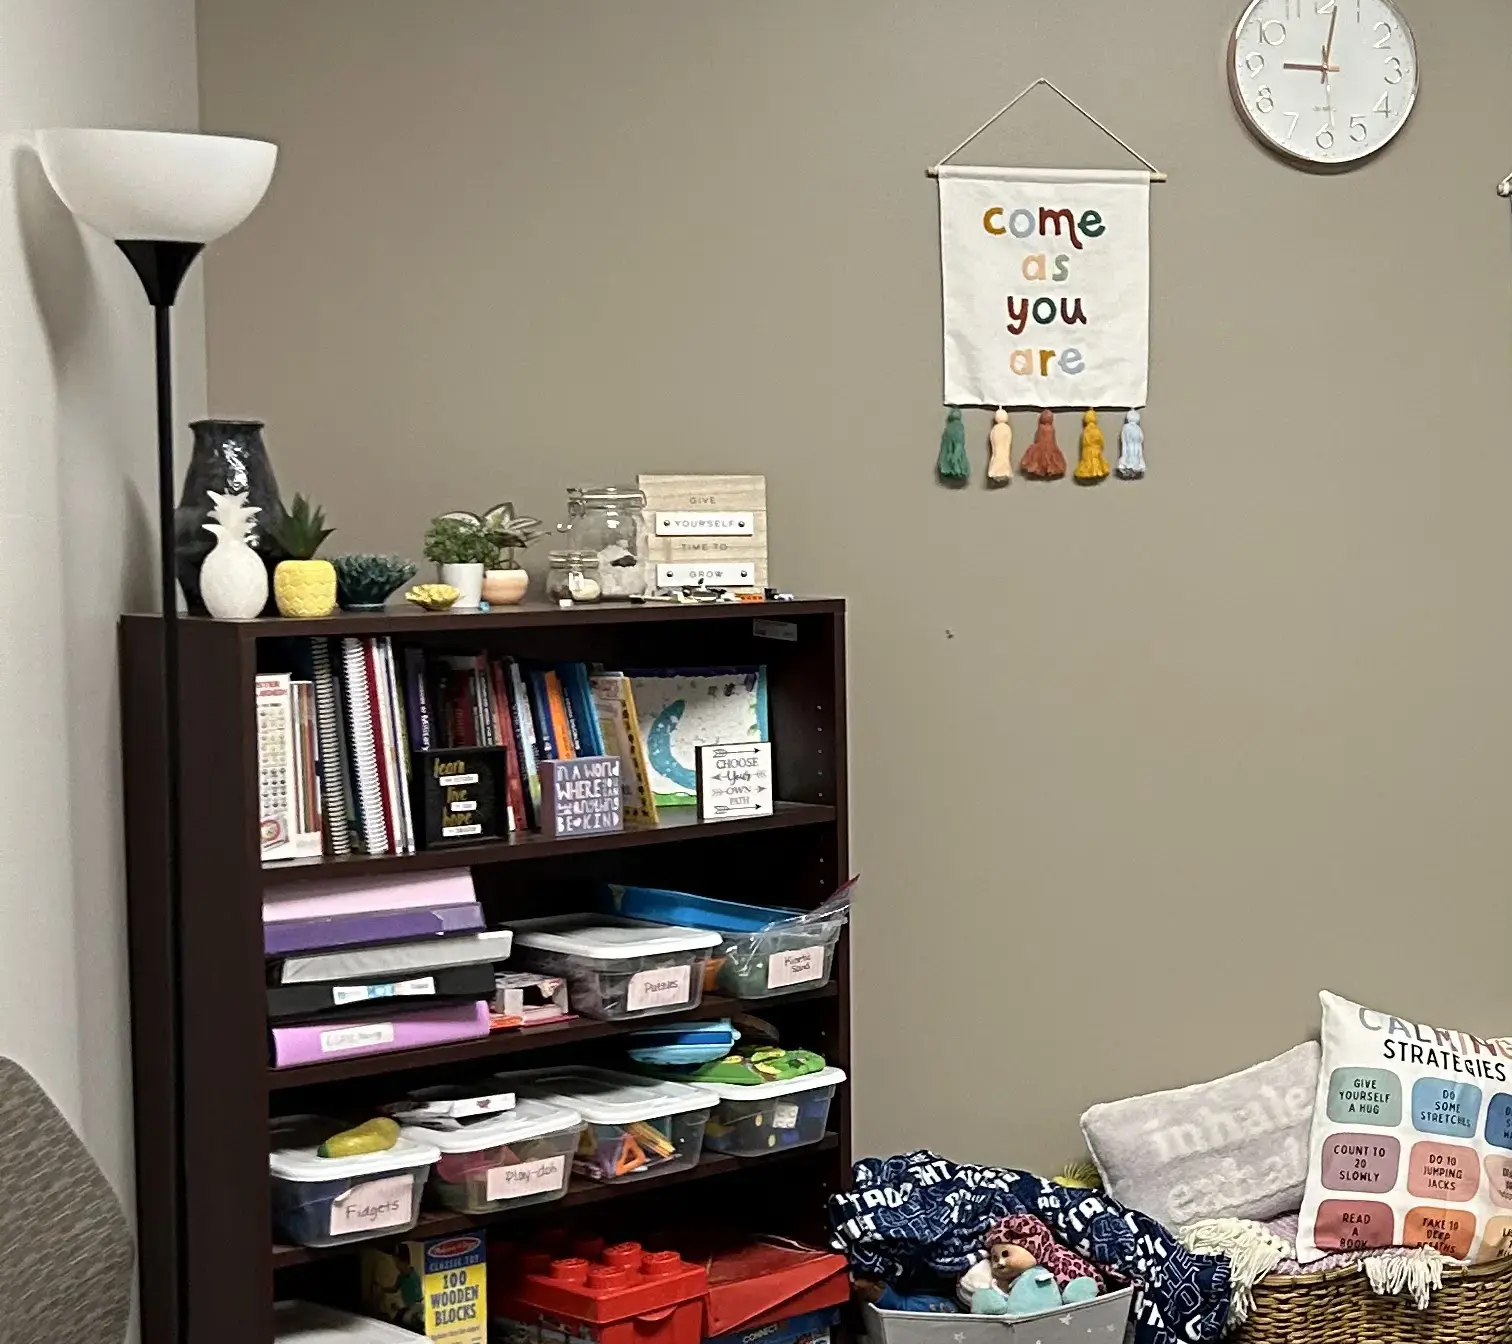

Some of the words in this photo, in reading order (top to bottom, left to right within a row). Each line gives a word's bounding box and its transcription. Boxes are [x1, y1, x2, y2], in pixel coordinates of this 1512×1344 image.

[1257, 18, 1286, 46] 10
[1373, 21, 1391, 49] 2
[1246, 52, 1264, 79] 9
[1384, 57, 1402, 84] 3
[1256, 85, 1273, 113] 8
[1372, 91, 1391, 118] 4
[1284, 112, 1299, 139] 7
[1350, 116, 1367, 142] 5
[1316, 122, 1334, 149] 6
[983, 206, 1106, 249] come
[1022, 254, 1070, 282] as
[1007, 295, 1087, 335] you
[1009, 347, 1085, 377] are
[689, 496, 716, 505] GIVE
[674, 519, 735, 528] YOURSELF
[681, 543, 709, 551] TIME
[713, 543, 728, 551] TO
[689, 570, 724, 579] GROW
[716, 757, 759, 769] CHOOSE
[556, 778, 602, 800] WHERE
[729, 796, 750, 805] PATH
[557, 816, 573, 832] BE
[583, 811, 619, 830] KIND
[1383, 1038, 1507, 1082] STRATEGIES
[1353, 1078, 1377, 1090] GIVE
[1339, 1090, 1391, 1104] YOURSELF
[1442, 1089, 1456, 1101] DO
[1349, 1103, 1356, 1112] A
[1359, 1103, 1380, 1115] HUG
[1435, 1101, 1461, 1113] SOME
[1420, 1111, 1472, 1128] STRETCHES
[1333, 1144, 1369, 1157] COUNT
[1373, 1146, 1386, 1157] TO
[1354, 1158, 1367, 1169] 20
[1429, 1154, 1443, 1165] DO
[1446, 1155, 1457, 1166] 10
[1339, 1169, 1380, 1182] SLOWLY
[1423, 1166, 1463, 1180] JUMPING
[1428, 1178, 1456, 1191] JACKS
[345, 1199, 399, 1224] Fidgets
[1342, 1213, 1371, 1224] READ
[1422, 1217, 1446, 1230] TAKE
[1449, 1220, 1459, 1231] 10
[1352, 1228, 1359, 1236] A
[1426, 1230, 1451, 1242] DEEP
[1339, 1239, 1368, 1249] BOOK
[443, 1270, 467, 1289] 100
[430, 1285, 480, 1309] WOODEN
[435, 1303, 477, 1327] BLOCKS
